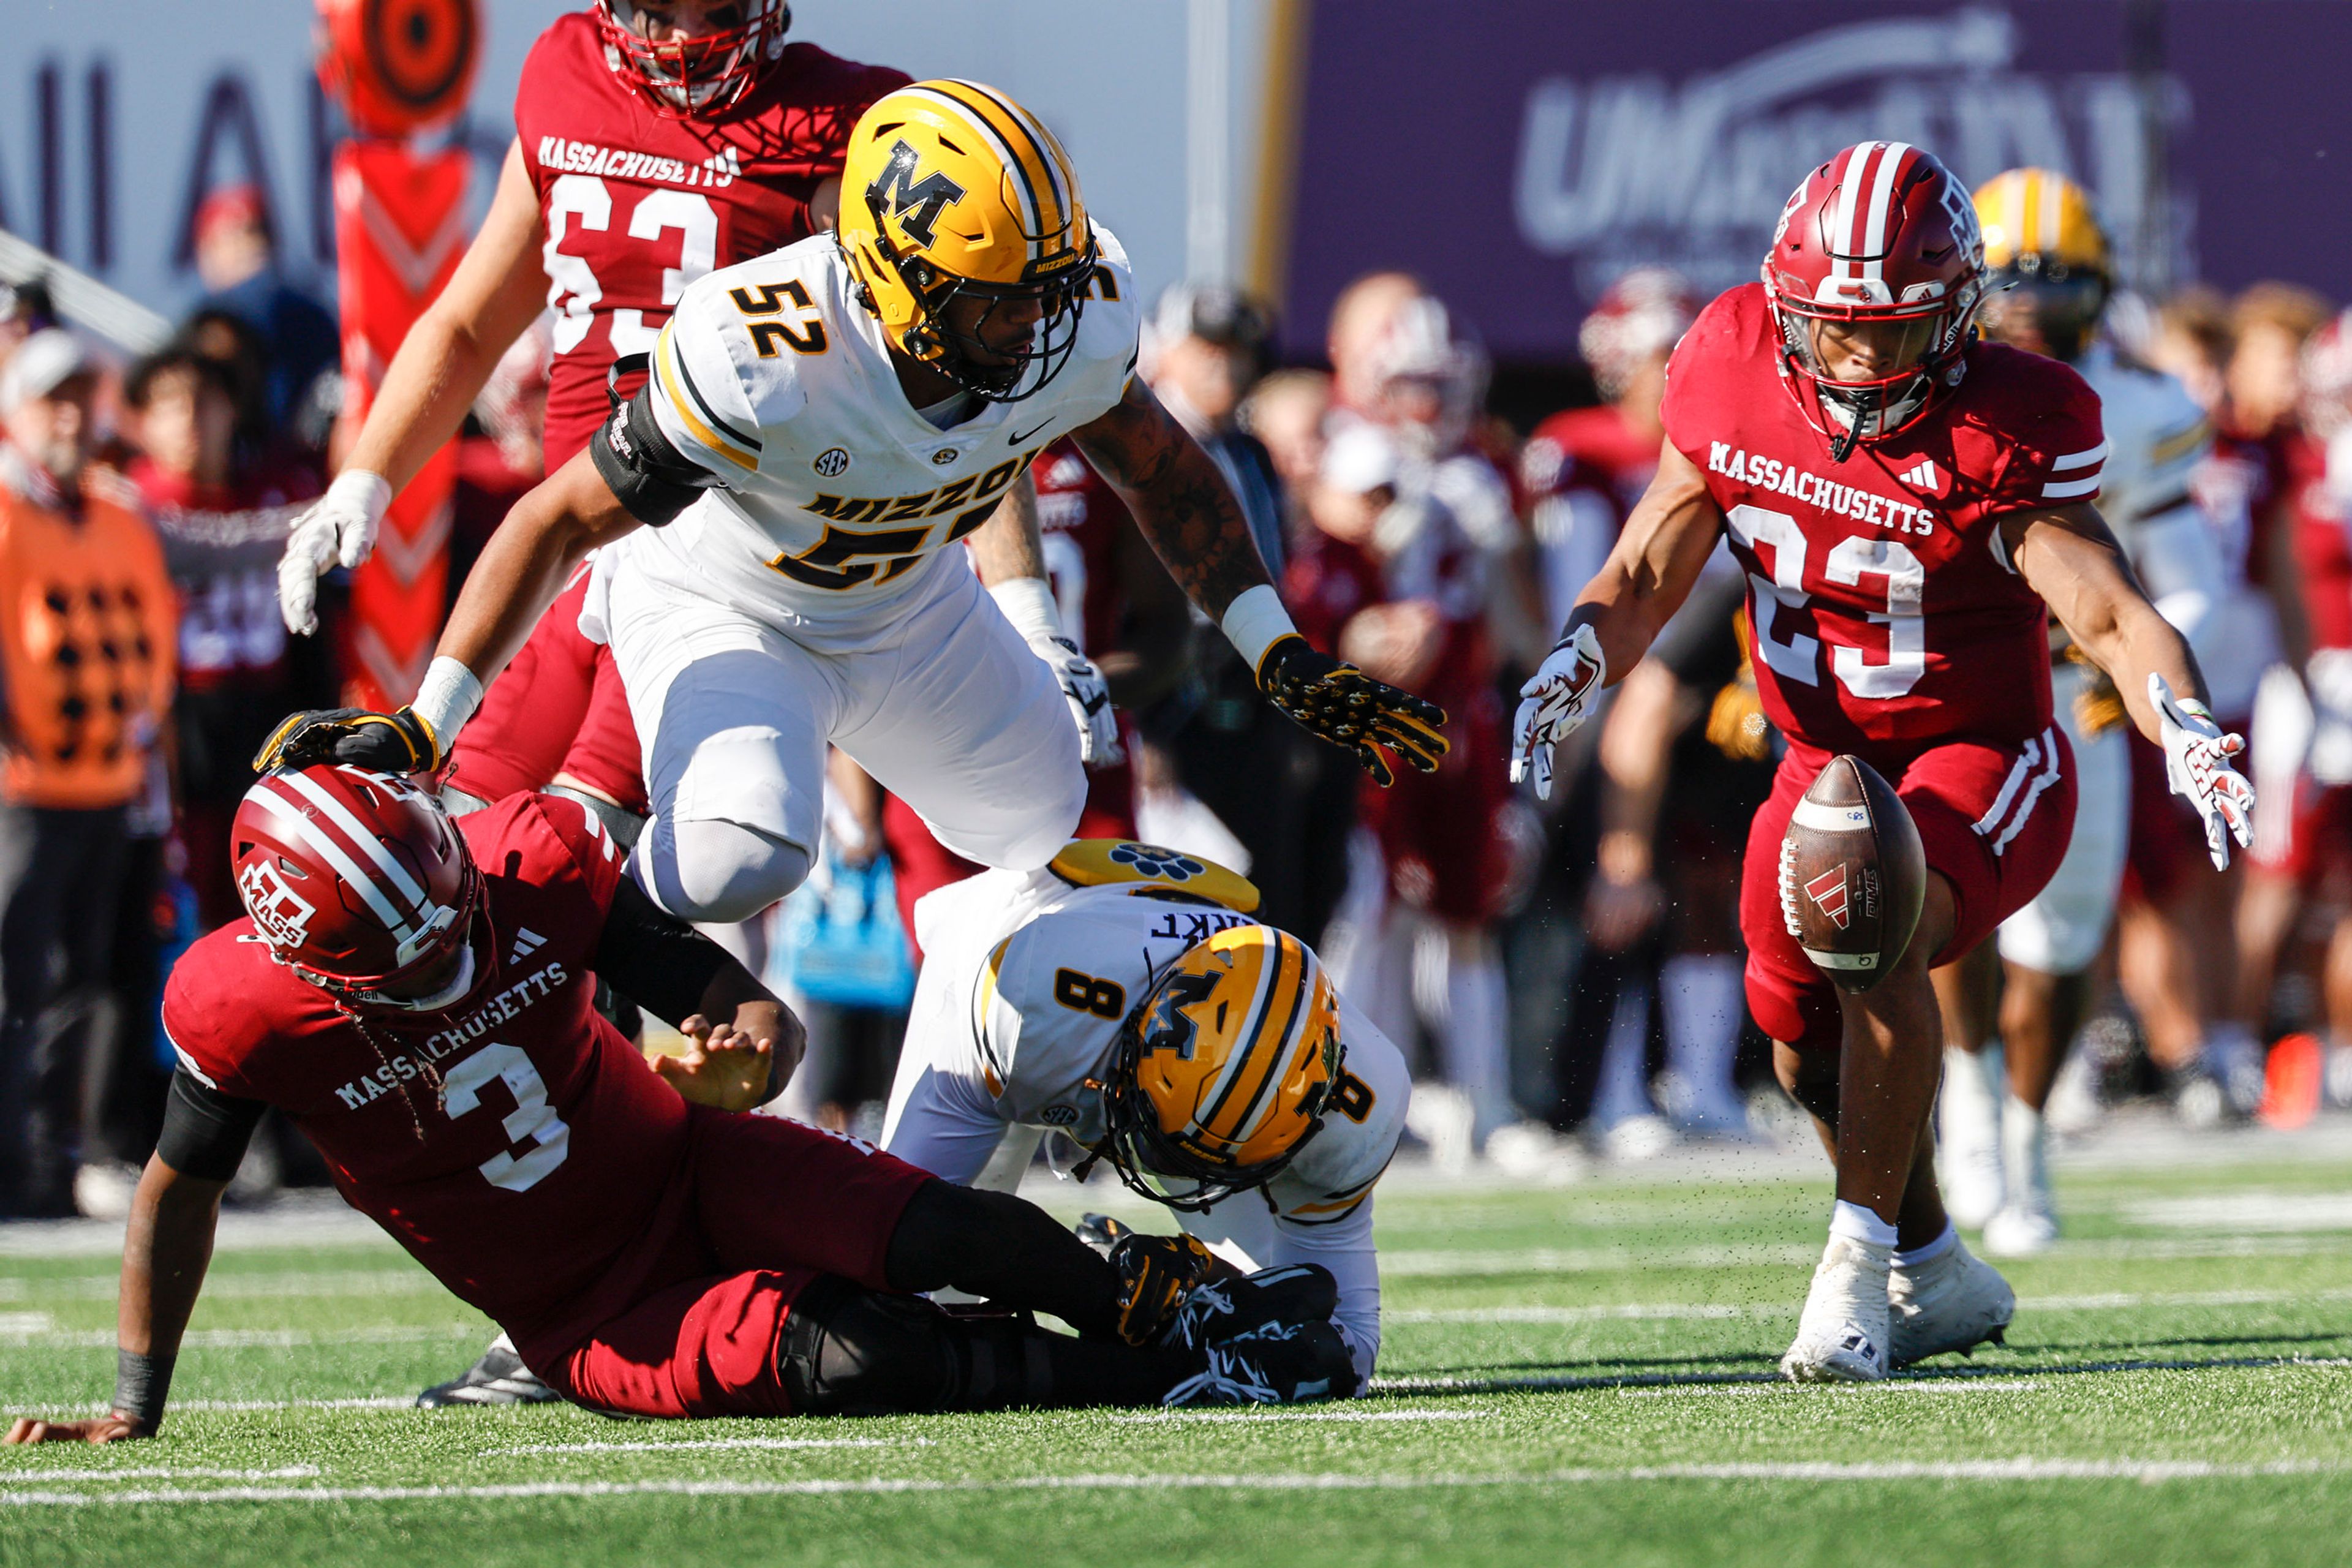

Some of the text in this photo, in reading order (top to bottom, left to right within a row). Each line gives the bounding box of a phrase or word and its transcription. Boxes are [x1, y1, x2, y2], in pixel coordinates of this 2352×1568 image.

[864, 137, 967, 250] M
[543, 174, 718, 362] 63
[1036, 253, 1074, 273] MIZZOU
[728, 277, 829, 358] 52
[816, 448, 848, 477] SEC
[1708, 441, 1934, 536] MASSACHUSETTS
[1727, 503, 1924, 699] 23
[1863, 868, 1879, 919] DIME
[1054, 967, 1126, 1021] 8
[1143, 968, 1224, 1061] M
[443, 1042, 570, 1192] 3
